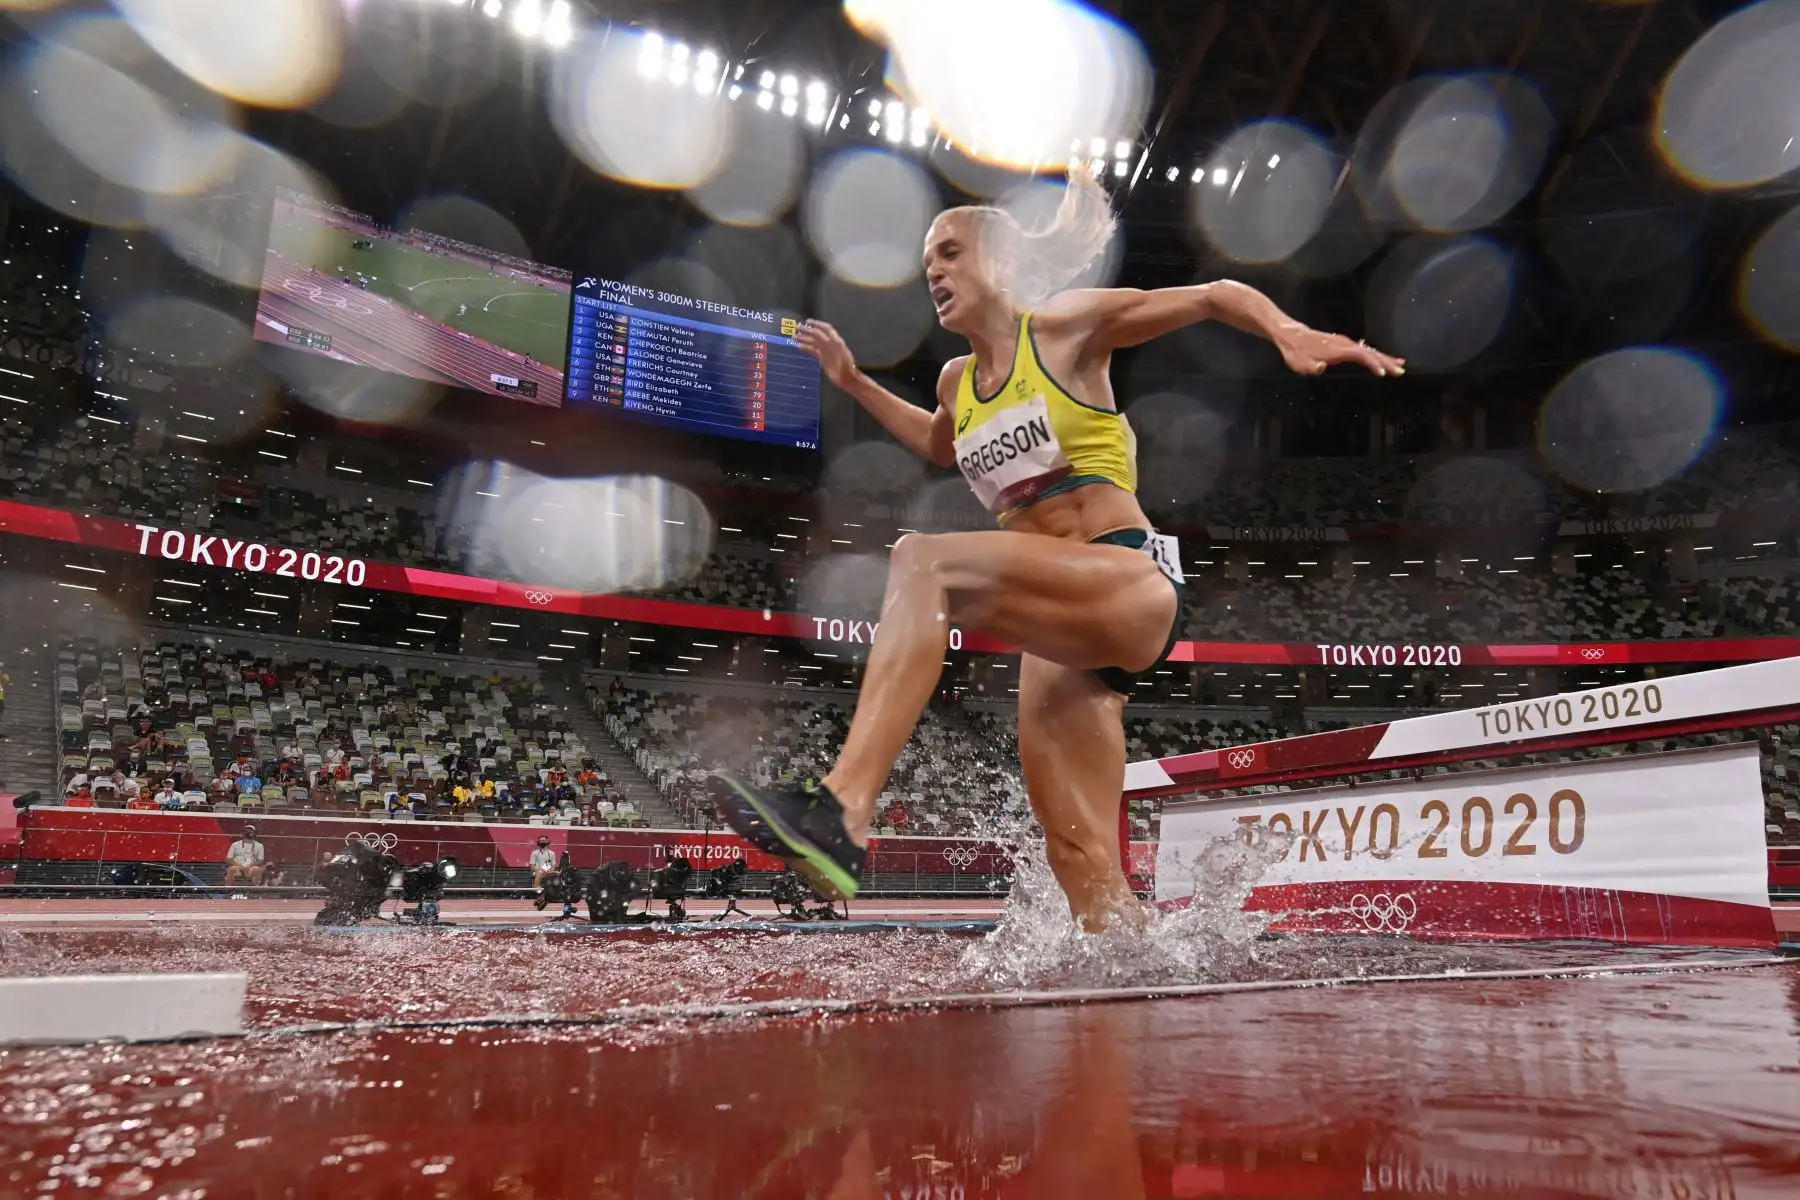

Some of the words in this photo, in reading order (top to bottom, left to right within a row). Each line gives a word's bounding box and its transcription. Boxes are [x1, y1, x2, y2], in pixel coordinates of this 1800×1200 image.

[577, 296, 601, 307] START
[602, 303, 617, 311] LIST
[600, 290, 634, 306] FINAL
[601, 278, 654, 299] WOMEN'S
[657, 291, 693, 308] 3000M
[696, 299, 774, 323] STEEPLECHASE
[595, 321, 614, 330] UGA
[630, 328, 670, 342] CHEMUTAI
[671, 337, 694, 347] Peruth
[599, 312, 615, 321] USA
[631, 318, 669, 331] CONSTIEN
[671, 326, 695, 337] Valerie
[594, 341, 613, 350] CAN
[630, 348, 665, 361] LALONDE
[666, 356, 703, 369] Genevieve
[597, 332, 613, 341] KEN
[630, 338, 677, 353] CHEPKOECH
[678, 348, 707, 360] Beatrice
[595, 353, 611, 361] USA
[628, 359, 663, 372] FRERICHS
[665, 366, 698, 379] Courtney
[595, 362, 611, 372] ETH
[627, 368, 692, 387] WONDEMAGEGN
[693, 381, 712, 391] Zerfe
[593, 373, 610, 382] GBR
[626, 379, 644, 389] BIRD
[645, 383, 679, 395] Elizabeth
[594, 383, 609, 392] ETH
[625, 390, 651, 401] ABEBE
[652, 395, 682, 406] Mekides
[592, 394, 609, 402] KEN
[625, 400, 654, 412] KIYENG
[655, 405, 676, 416] Hyvin
[960, 415, 1051, 480] GREGSON
[135, 524, 267, 572] TOKYO
[276, 549, 366, 587] 2020
[812, 616, 881, 645] TOKY
[1317, 644, 1397, 666] TOKYO
[1402, 645, 1462, 666] 2020
[1475, 698, 1573, 737] TOKYO
[1580, 684, 1662, 723] 2020
[1238, 802, 1401, 863] TOKYO
[1417, 788, 1586, 859] 2020
[706, 845, 741, 859] 2020
